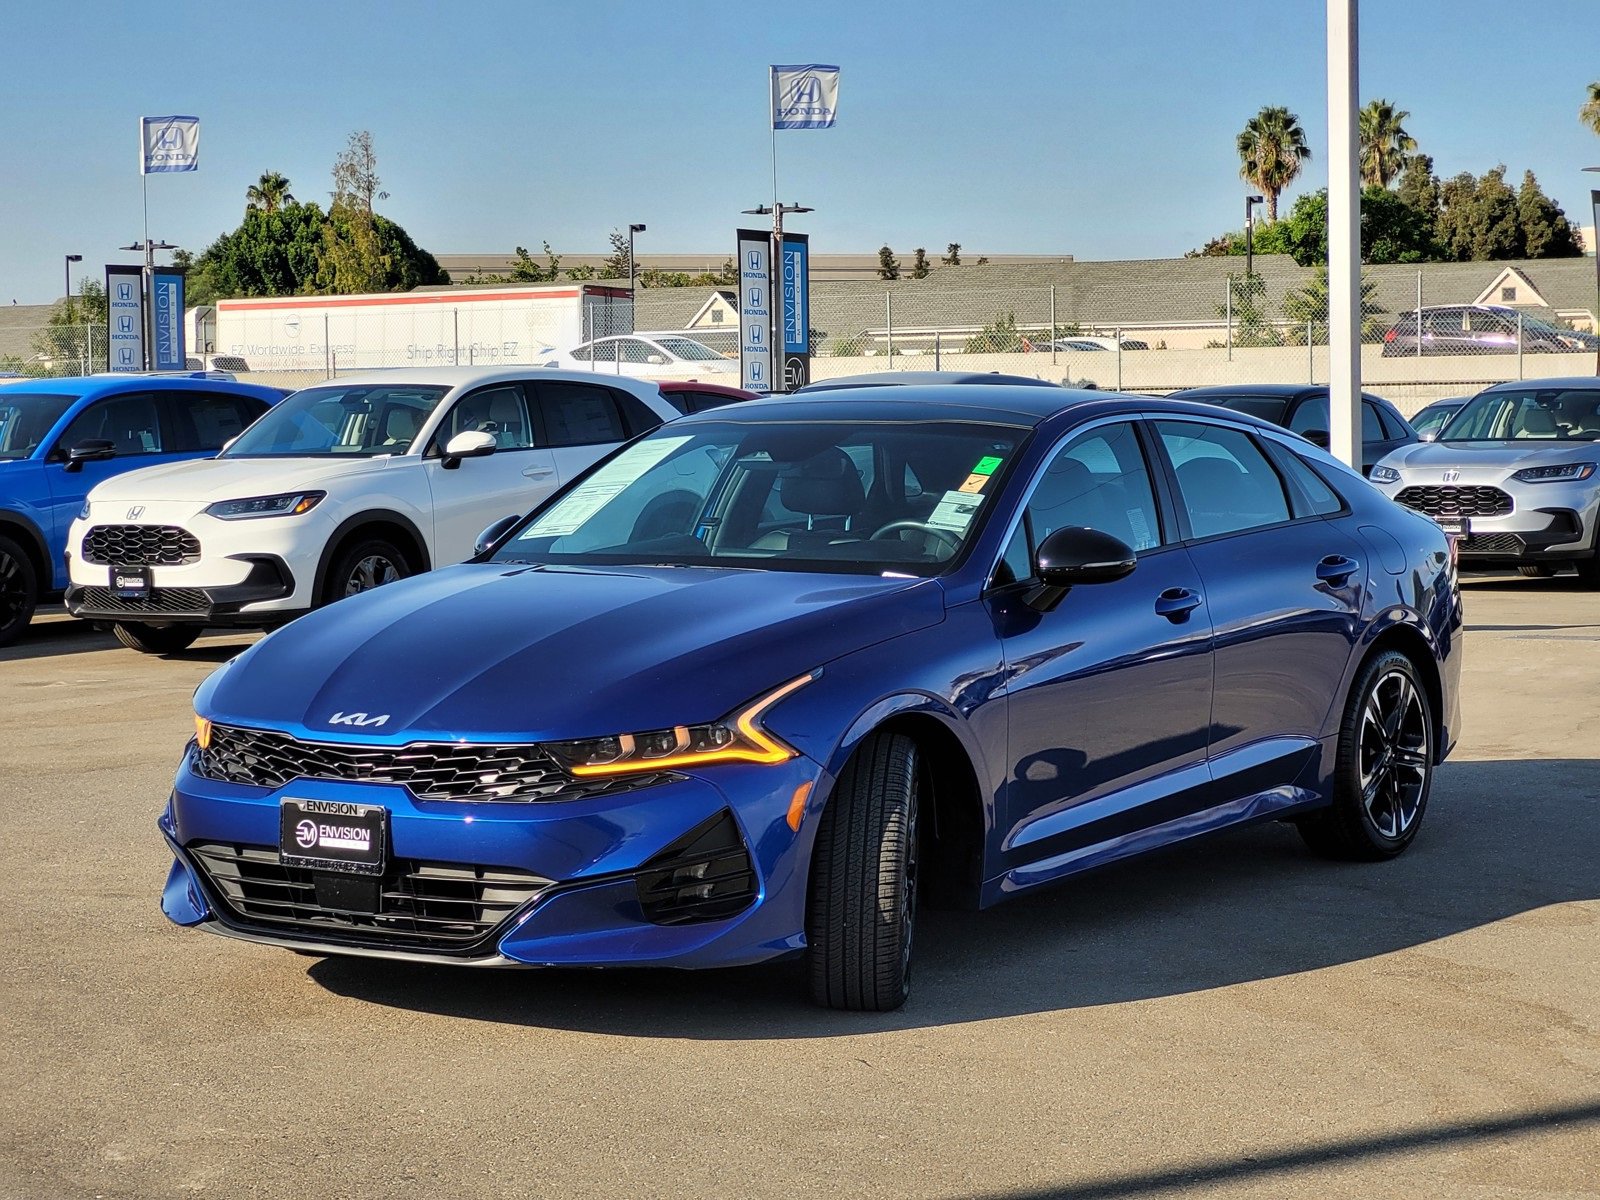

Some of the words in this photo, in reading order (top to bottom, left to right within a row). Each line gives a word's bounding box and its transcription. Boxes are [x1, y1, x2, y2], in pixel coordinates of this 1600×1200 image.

[776, 107, 831, 117] HONDA
[784, 251, 795, 344] ENVISION
[158, 282, 170, 364] ENVISION
[231, 344, 244, 355] EZ
[247, 344, 305, 356] Worldwide
[407, 344, 433, 362] Ship
[472, 341, 498, 362] Ship
[503, 341, 518, 356] EZ
[306, 801, 358, 815] ENVISION
[319, 824, 370, 841] ENVISION
